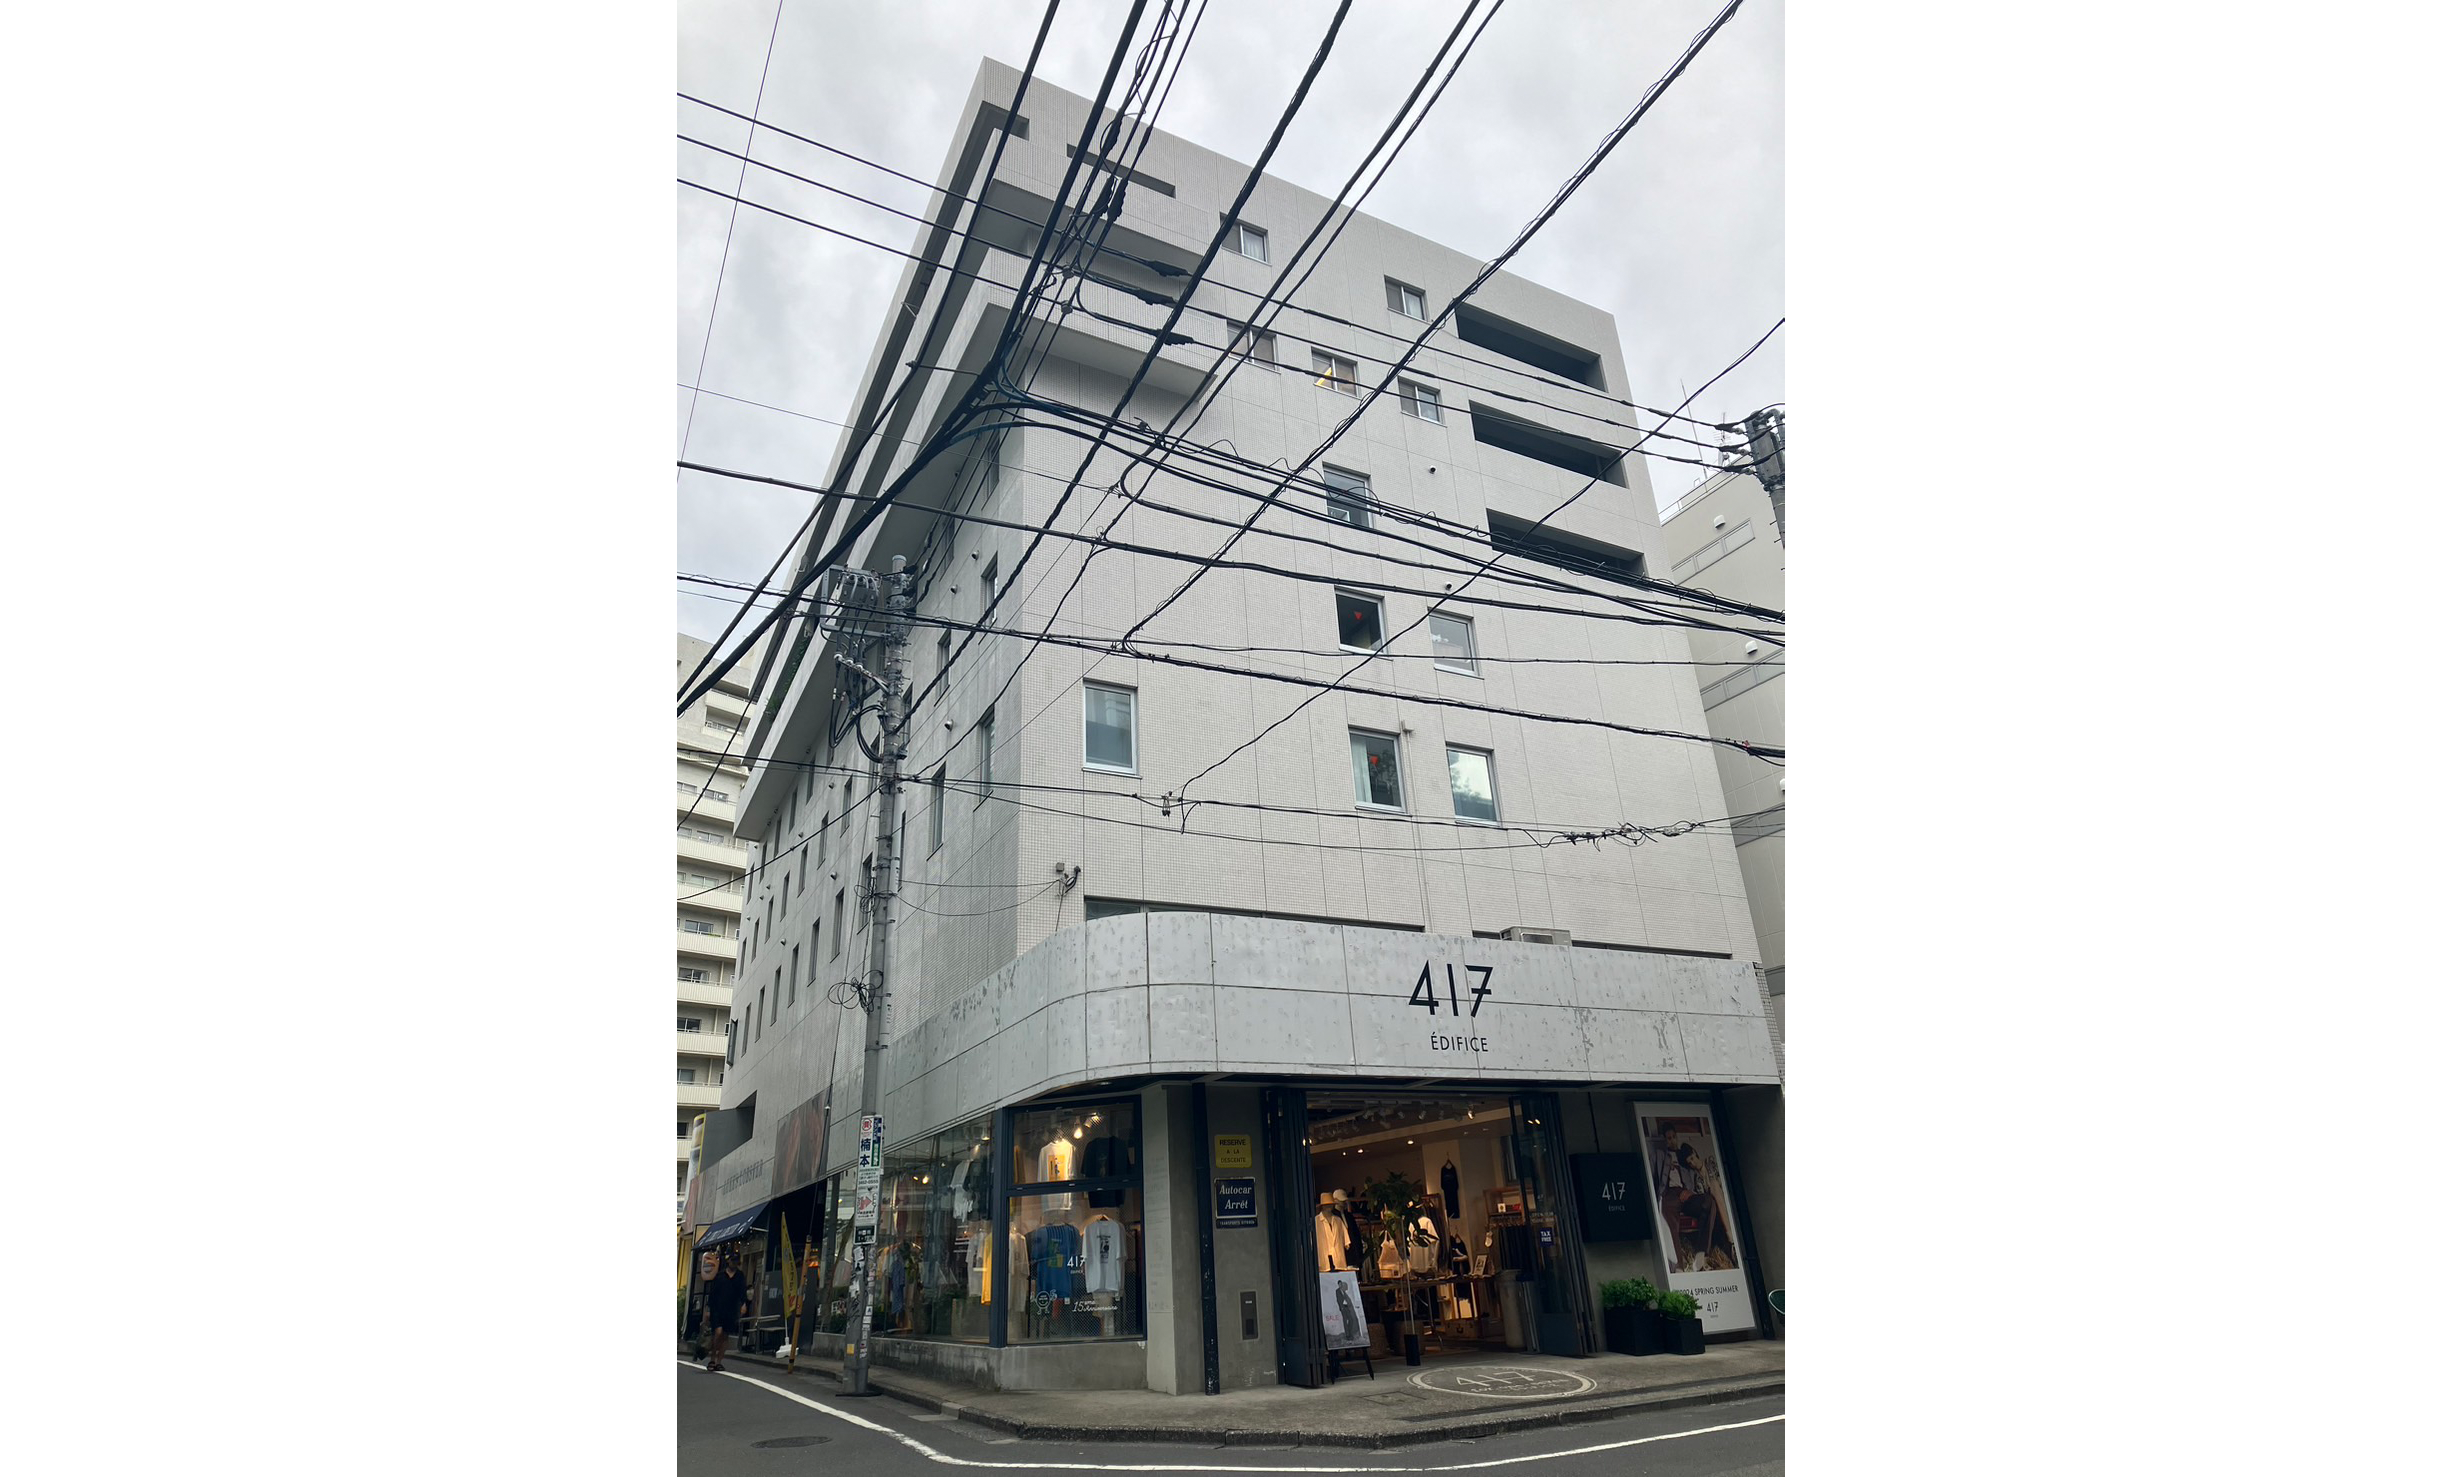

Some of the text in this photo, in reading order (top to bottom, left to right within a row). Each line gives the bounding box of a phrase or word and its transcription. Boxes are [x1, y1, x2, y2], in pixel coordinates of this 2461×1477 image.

[1408, 959, 1494, 1018] 417
[1430, 1031, 1489, 1052] ÉDIFICE
[1219, 1184, 1253, 1195] Autocar
[1602, 1182, 1626, 1201] 417
[1067, 1255, 1086, 1268] 417
[1694, 1286, 1715, 1296] SPRING
[1715, 1284, 1739, 1295] SUMMER
[1706, 1301, 1719, 1313] 417
